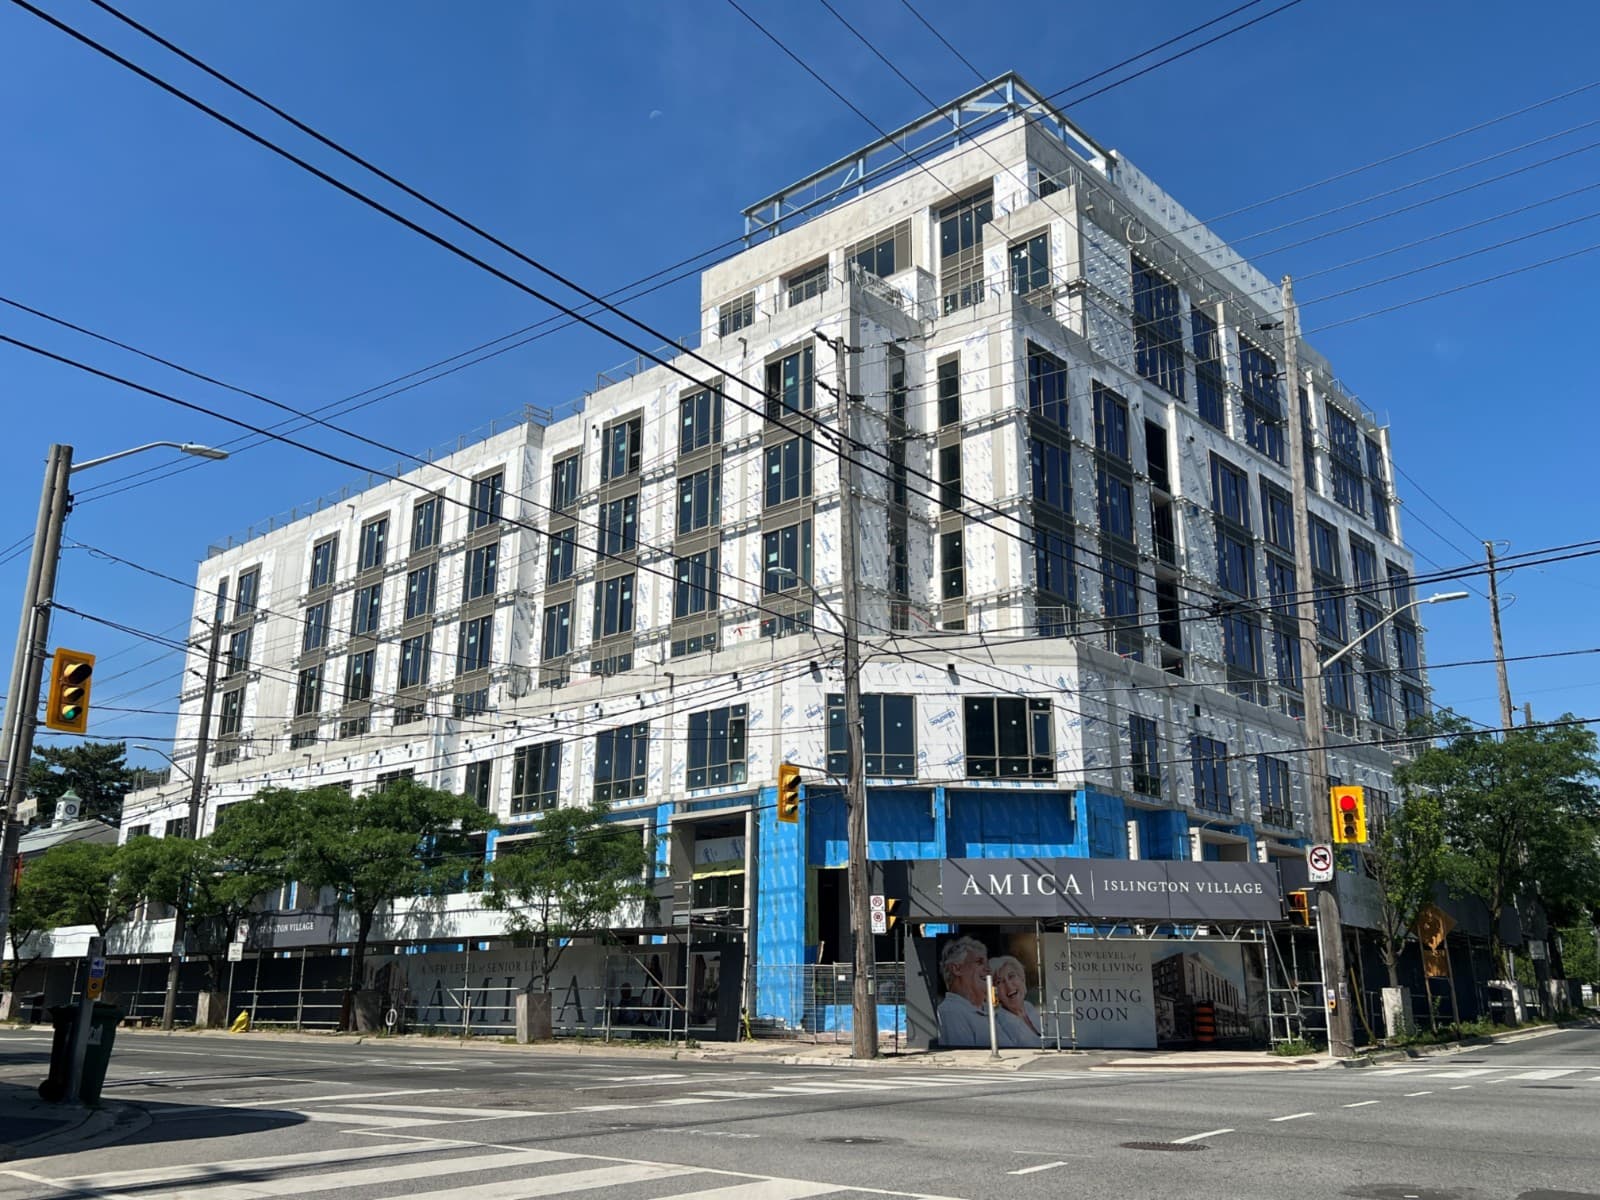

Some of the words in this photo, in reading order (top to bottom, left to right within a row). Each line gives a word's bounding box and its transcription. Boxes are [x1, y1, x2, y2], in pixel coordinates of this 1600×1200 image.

[962, 873, 1083, 897] AMICA
[1103, 879, 1190, 893] ISLINGTON
[1196, 881, 1264, 895] VILLAGE
[487, 960, 521, 973] SENIOR
[1054, 962, 1098, 972] SENIOR
[1102, 962, 1144, 973] LIVING
[1060, 988, 1142, 1003] COMING
[1075, 1007, 1129, 1021] SOON
